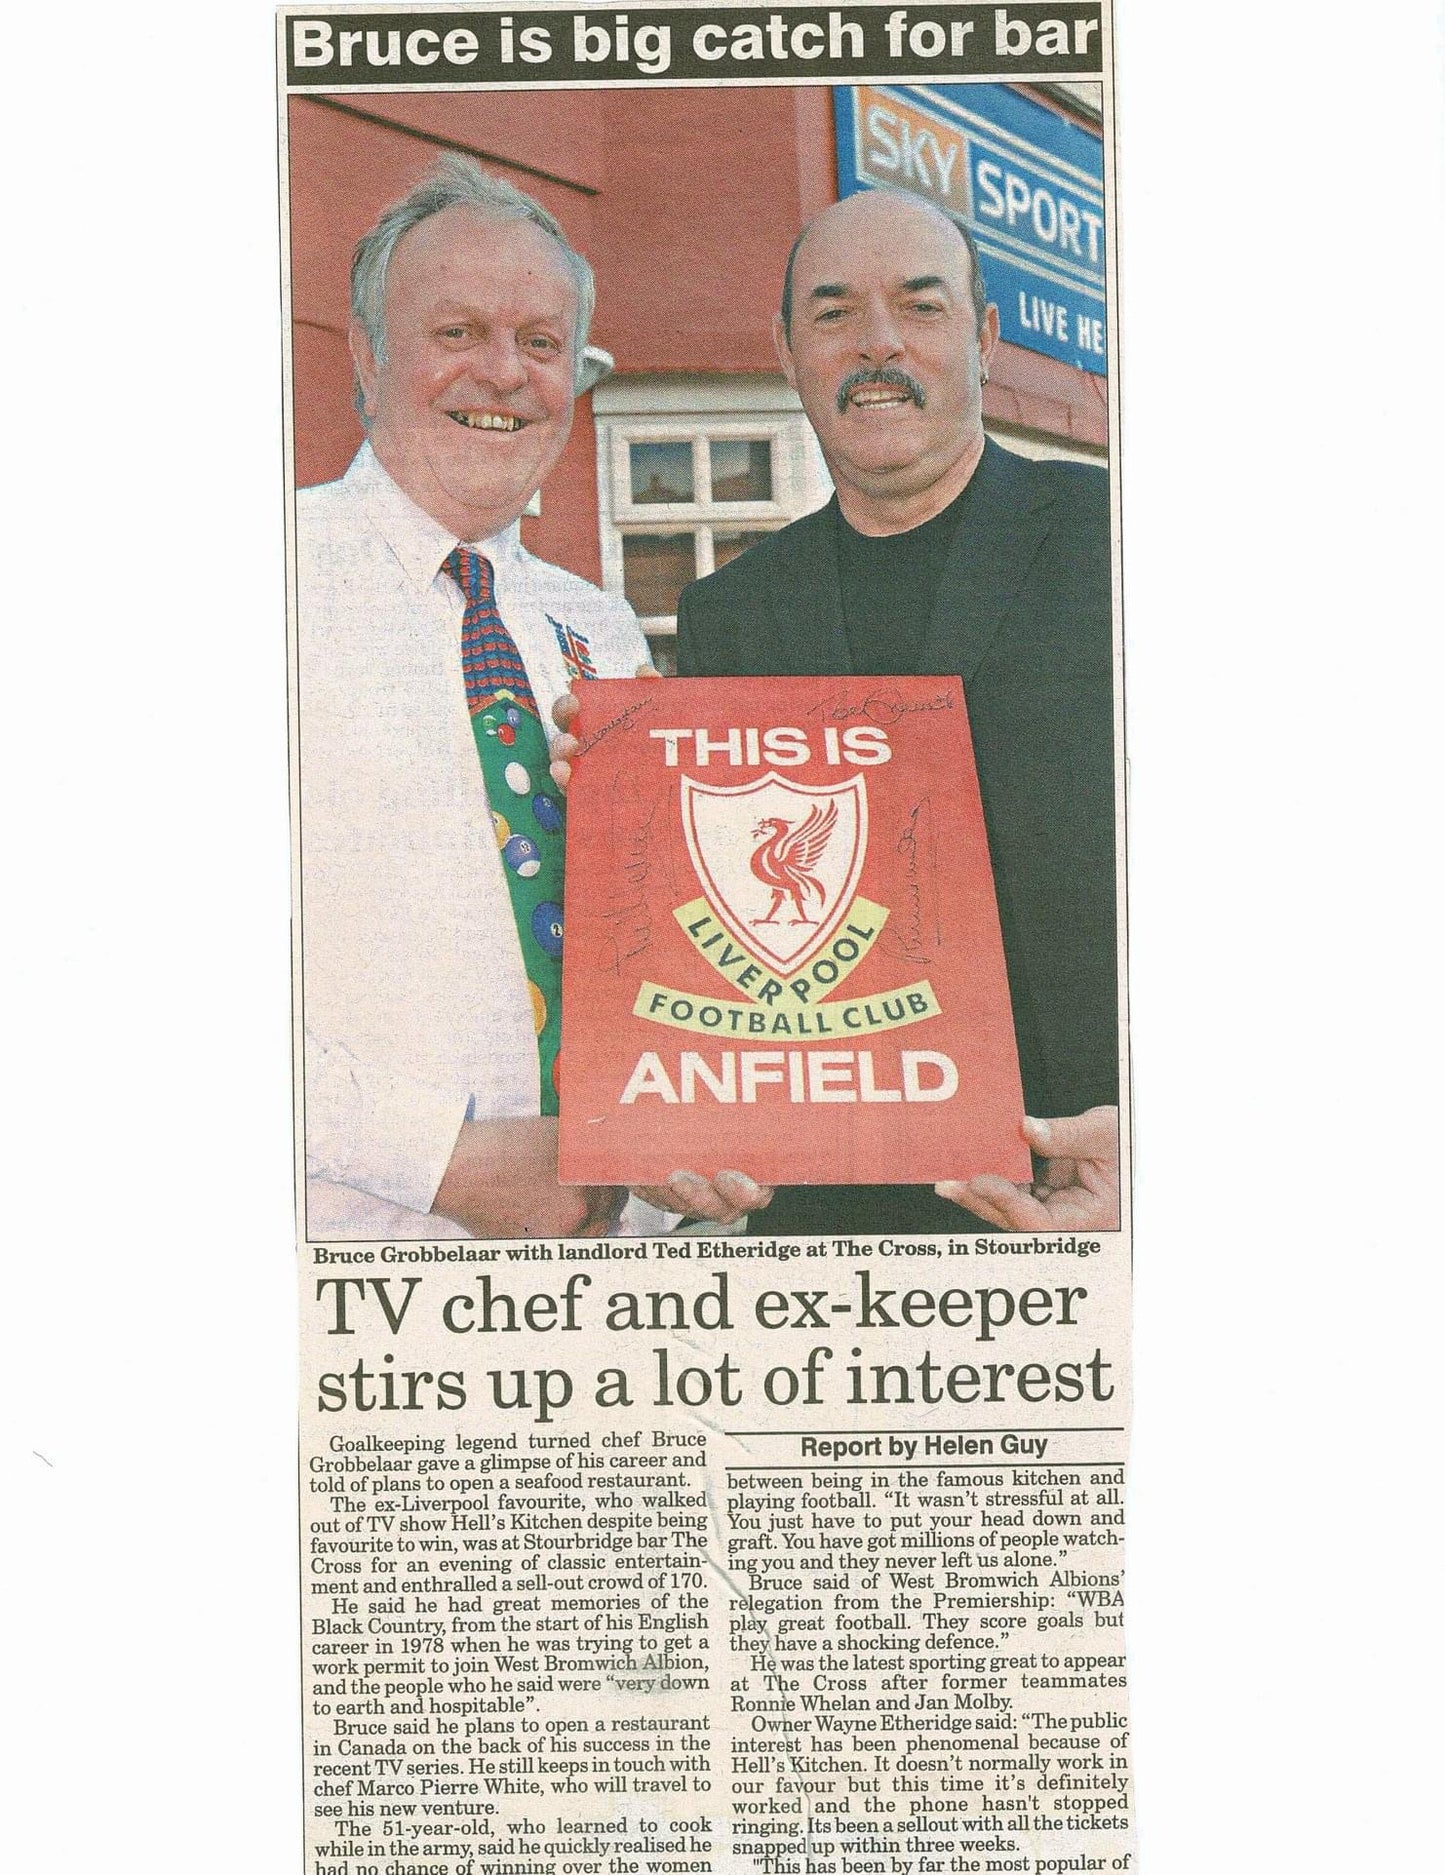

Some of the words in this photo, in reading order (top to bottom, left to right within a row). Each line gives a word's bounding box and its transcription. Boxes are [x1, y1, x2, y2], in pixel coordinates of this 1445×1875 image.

[293, 20, 479, 67] Bruce
[501, 17, 553, 64] is
[574, 15, 672, 74] big
[693, 12, 865, 61] catch
[885, 10, 975, 57] for
[995, 9, 1099, 56] bar
[866, 103, 958, 196] SKY
[1018, 291, 1069, 343] LIVE
[648, 726, 812, 768] THIS
[826, 725, 893, 767] IS
[687, 915, 875, 1006] LIVERPOOL
[649, 991, 833, 1036] FOOTBALL
[841, 991, 929, 1029] CLUB
[618, 1049, 960, 1105] ANFIELD
[314, 1247, 374, 1264] Bruce
[380, 1246, 501, 1263] Grobbelaar
[505, 1244, 552, 1261] with
[557, 1243, 648, 1260] landlord
[653, 1242, 692, 1259] Ted
[697, 1241, 802, 1264] Etheridge
[806, 1243, 828, 1258] at
[832, 1240, 871, 1257] The
[877, 1240, 943, 1261] Cross,
[948, 1239, 970, 1256] in
[976, 1237, 1101, 1258] Stourbridge
[316, 1278, 422, 1334] TV
[443, 1274, 591, 1333] chef
[606, 1272, 734, 1331] and
[756, 1270, 1087, 1341] ex-keeper
[319, 1358, 466, 1412] stirs
[487, 1370, 573, 1420] up
[595, 1369, 634, 1407] a
[653, 1348, 742, 1406] lot
[764, 1347, 833, 1405] of
[847, 1348, 1114, 1404] interest
[330, 1435, 445, 1455] Goalkeeping
[456, 1433, 518, 1454] legend
[529, 1432, 591, 1448] turned
[602, 1431, 642, 1447] chef
[652, 1431, 706, 1447] Bruce
[802, 1436, 882, 1459] Report
[889, 1436, 917, 1460] by
[925, 1435, 993, 1455] Helen
[1000, 1434, 1048, 1458] Guy
[310, 1455, 412, 1473] Grobbelaar
[418, 1460, 459, 1475] gave
[465, 1460, 476, 1470] a
[480, 1454, 550, 1473] glimpse
[556, 1452, 575, 1468] of
[577, 1452, 604, 1468] his
[610, 1456, 667, 1468] career
[672, 1450, 707, 1467] and
[310, 1476, 345, 1492] told
[350, 1476, 369, 1492] of
[372, 1475, 421, 1495] plans
[426, 1476, 444, 1491] to
[450, 1479, 494, 1494] open
[500, 1479, 510, 1489] a
[516, 1472, 583, 1489] seafood
[588, 1472, 690, 1488] restaurant.
[727, 1473, 803, 1489] between
[811, 1472, 863, 1491] being
[871, 1472, 889, 1487] in
[898, 1471, 928, 1487] the
[937, 1471, 1003, 1487] famous
[1012, 1469, 1081, 1486] kitchen
[1090, 1468, 1125, 1484] and
[330, 1496, 366, 1512] The
[375, 1494, 489, 1514] ex-Liverpool
[498, 1493, 585, 1511] favourite,
[595, 1492, 633, 1508] who
[642, 1490, 707, 1508] walked
[727, 1493, 795, 1513] playing
[801, 1492, 876, 1508] football.
[986, 1489, 1063, 1506] stressful
[1071, 1490, 1089, 1505] at
[1097, 1488, 1123, 1505] all.
[749, 1574, 802, 1590] Bruce
[813, 1573, 850, 1590] said
[861, 1573, 880, 1589] of
[889, 1573, 934, 1589] West
[945, 1571, 1039, 1588] Bromwich
[332, 1598, 358, 1614] He
[369, 1597, 405, 1614] said
[415, 1597, 437, 1613] he
[448, 1596, 482, 1612] had
[493, 1596, 541, 1615] great
[551, 1594, 640, 1610] memories
[651, 1593, 670, 1609] of
[678, 1592, 708, 1608] the
[729, 1596, 823, 1615] relegation
[834, 1594, 879, 1609] from
[891, 1593, 921, 1609] the
[933, 1591, 1054, 1611] Premiership:
[731, 1696, 795, 1711] Ronnie
[800, 1695, 870, 1711] Whelan
[876, 1694, 910, 1710] and
[915, 1694, 949, 1710] Jan
[954, 1693, 1012, 1713] Molby.
[333, 1719, 387, 1735] Bruce
[394, 1718, 430, 1734] said
[436, 1718, 458, 1734] he
[465, 1717, 514, 1737] plans
[521, 1718, 539, 1732] to
[546, 1721, 588, 1736] open
[595, 1720, 606, 1731] a
[612, 1715, 710, 1731] restaurant
[752, 1716, 812, 1732] Owner
[815, 1715, 877, 1735] Wayne
[880, 1714, 971, 1734] Etheridge
[976, 1713, 1016, 1729] said:
[1070, 1712, 1127, 1732] public
[731, 1736, 801, 1751] interest
[811, 1736, 842, 1752] has
[852, 1735, 896, 1751] been
[906, 1733, 1019, 1754] phenomenal
[1028, 1733, 1100, 1749] because
[1110, 1732, 1130, 1748] of
[732, 1797, 802, 1814] worked
[815, 1796, 850, 1813] and
[864, 1796, 895, 1813] the
[910, 1795, 968, 1816] phone
[982, 1795, 1040, 1811] hasn't
[1054, 1793, 1128, 1814] stopped
[335, 1820, 371, 1836] The
[383, 1819, 494, 1839] 51-year-old,
[507, 1818, 545, 1834] who
[557, 1817, 628, 1833] learned
[639, 1818, 658, 1832] to
[670, 1816, 712, 1832] cook
[806, 1857, 836, 1874] has
[841, 1857, 886, 1873] been
[890, 1856, 913, 1875] by
[918, 1856, 945, 1872] far
[950, 1856, 980, 1872] the
[985, 1856, 1030, 1871] most
[1035, 1854, 1106, 1875] popular
[1112, 1853, 1131, 1869] of
